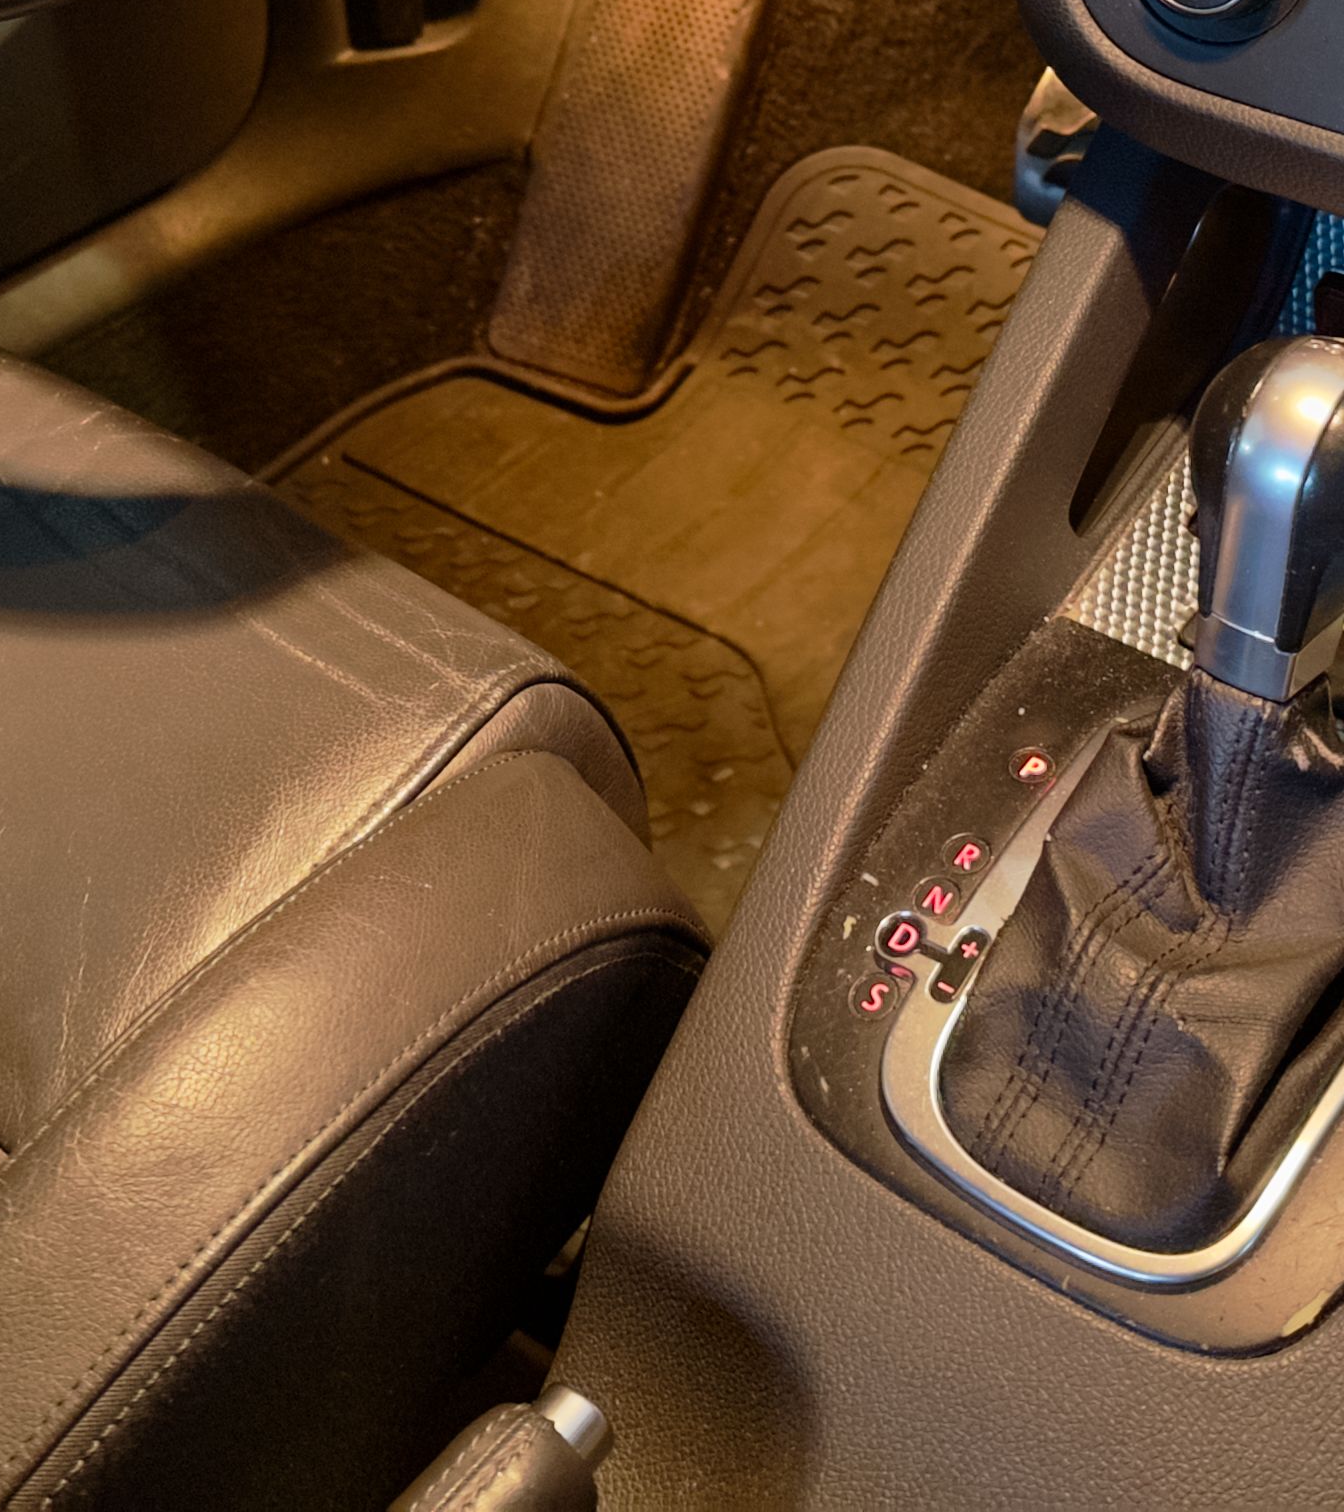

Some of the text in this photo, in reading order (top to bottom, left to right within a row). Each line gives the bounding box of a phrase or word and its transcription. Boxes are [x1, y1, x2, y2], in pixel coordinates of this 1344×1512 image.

[1019, 756, 1048, 778] P
[953, 843, 981, 870] R
[921, 885, 953, 915] N
[887, 922, 919, 952] D
[861, 983, 889, 1012] S
